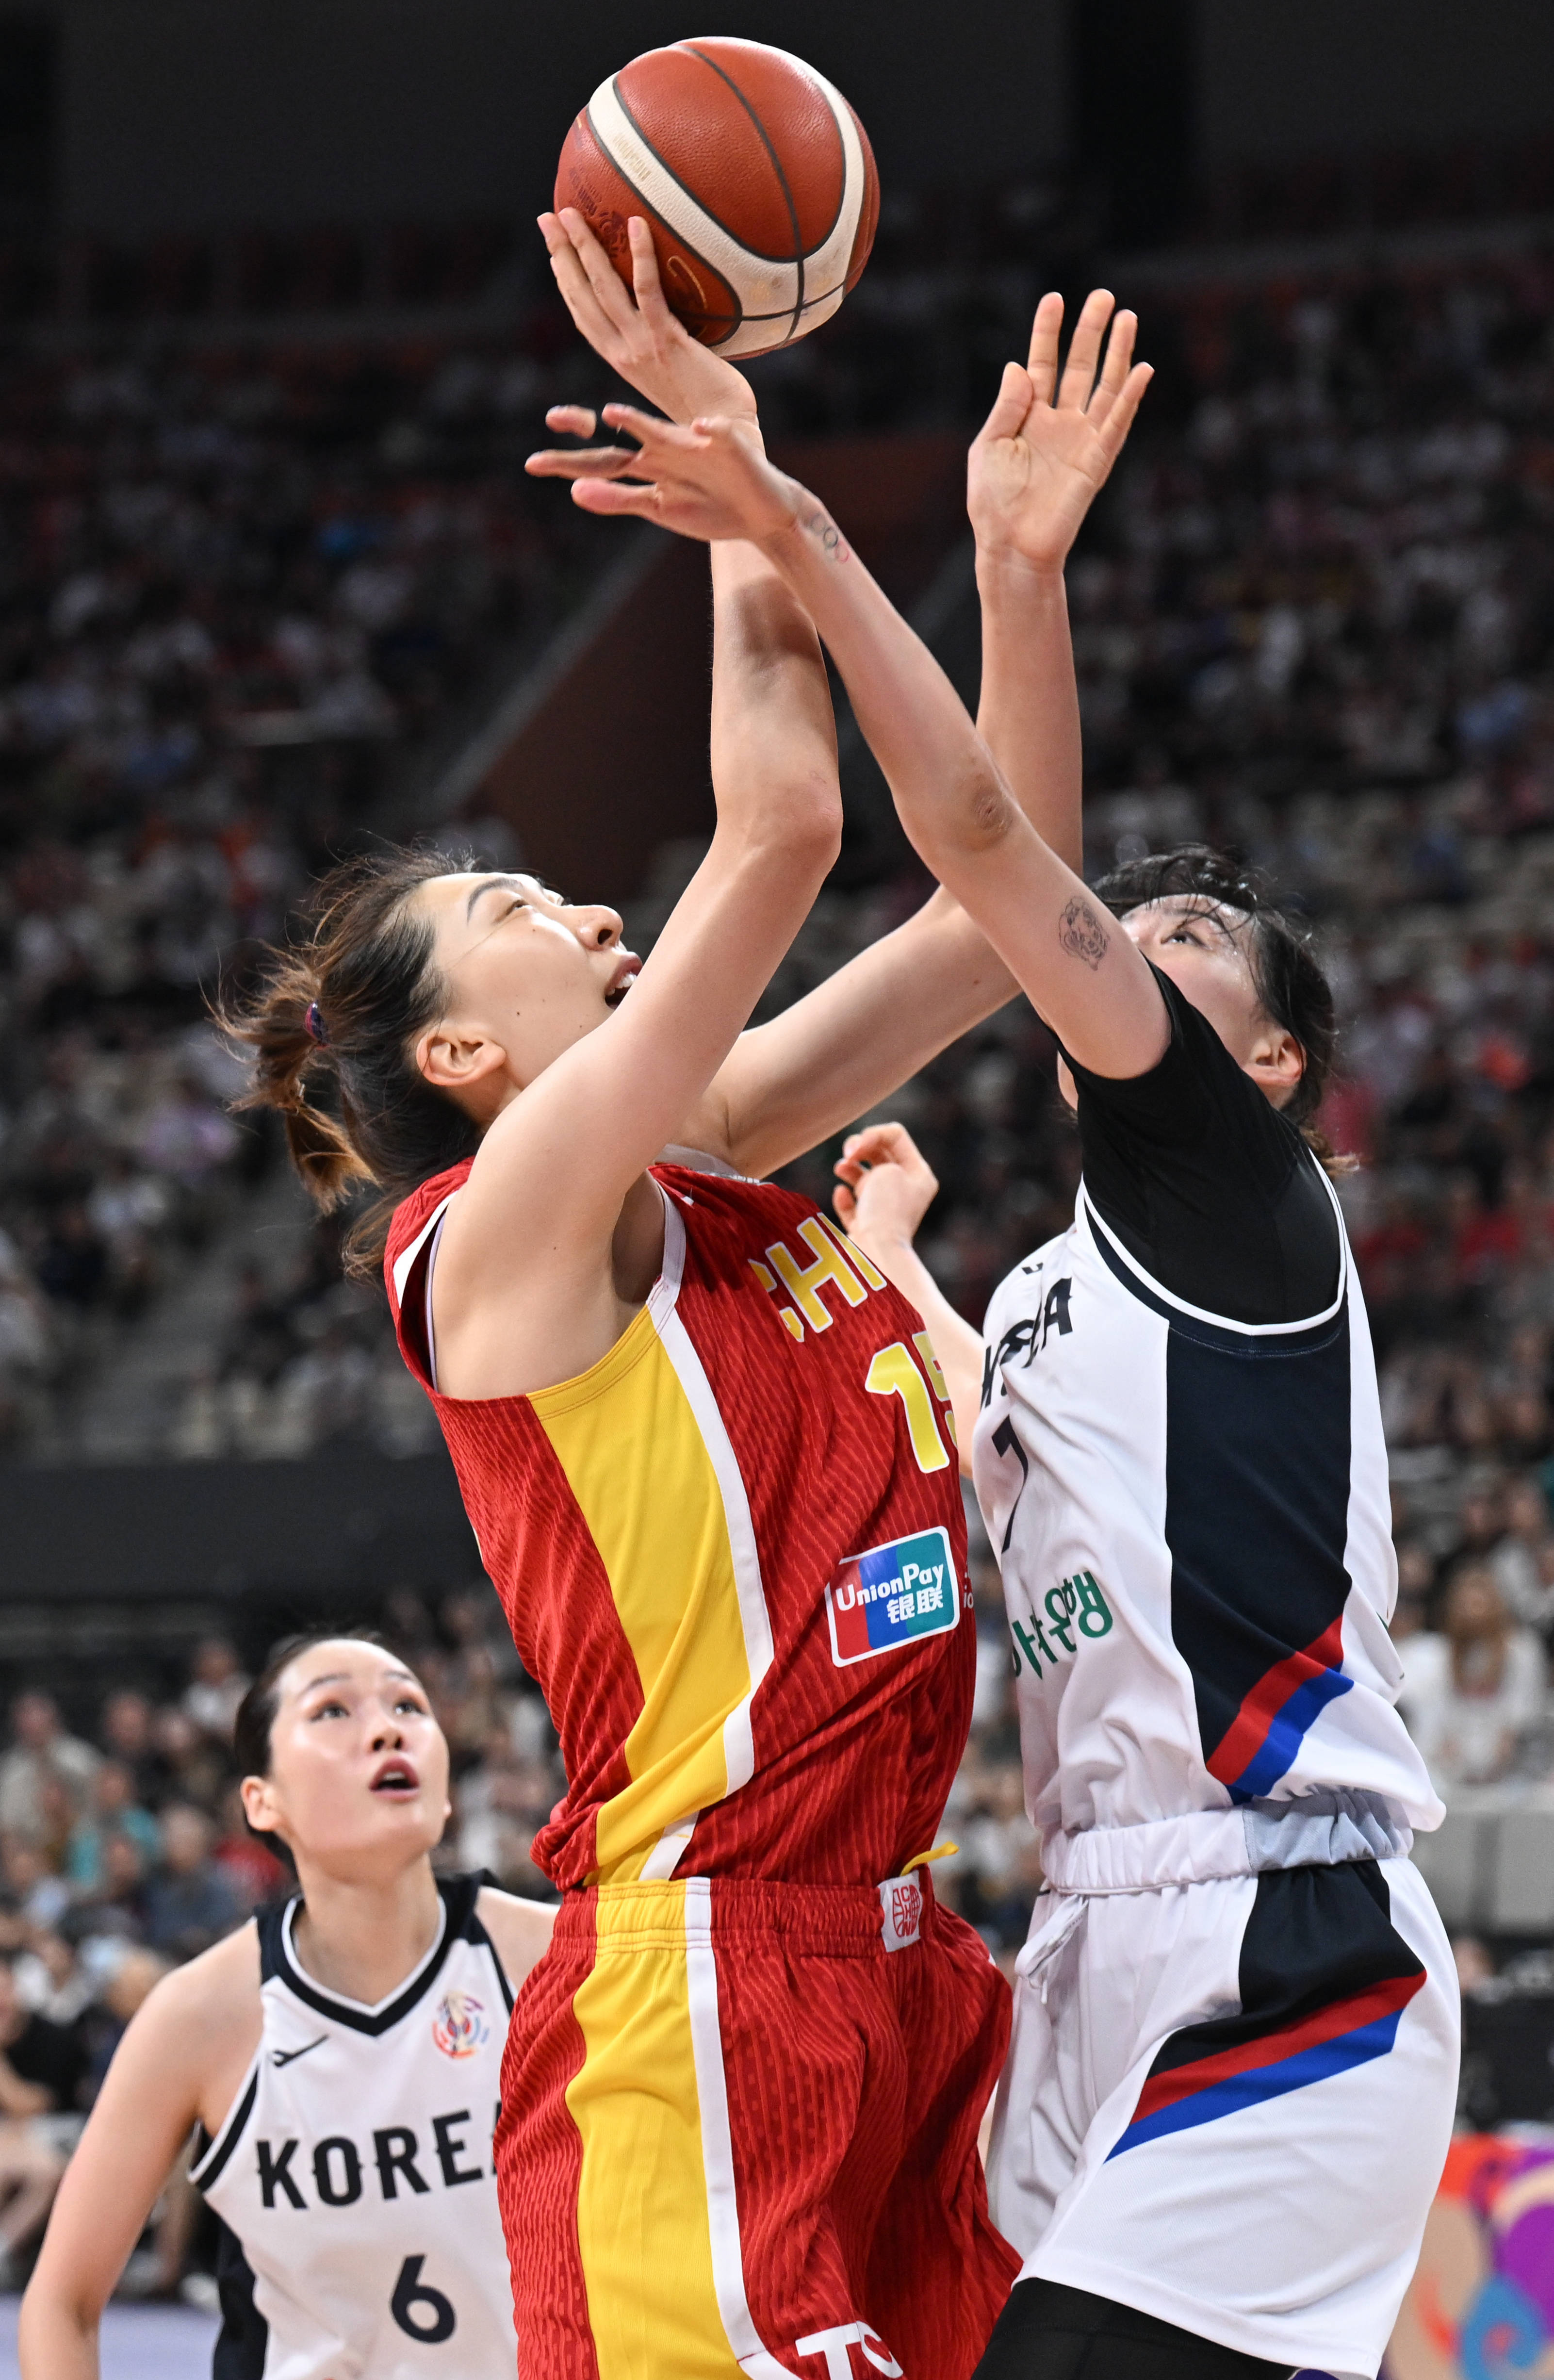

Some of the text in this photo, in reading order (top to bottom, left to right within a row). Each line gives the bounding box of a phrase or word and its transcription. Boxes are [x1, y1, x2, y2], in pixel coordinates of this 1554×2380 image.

[992, 1414, 1029, 1554] 7
[835, 1563, 944, 1611] UnionPay
[886, 1586, 944, 1625] 银联
[256, 2101, 501, 2211] KORE
[390, 2254, 457, 2345] 6
